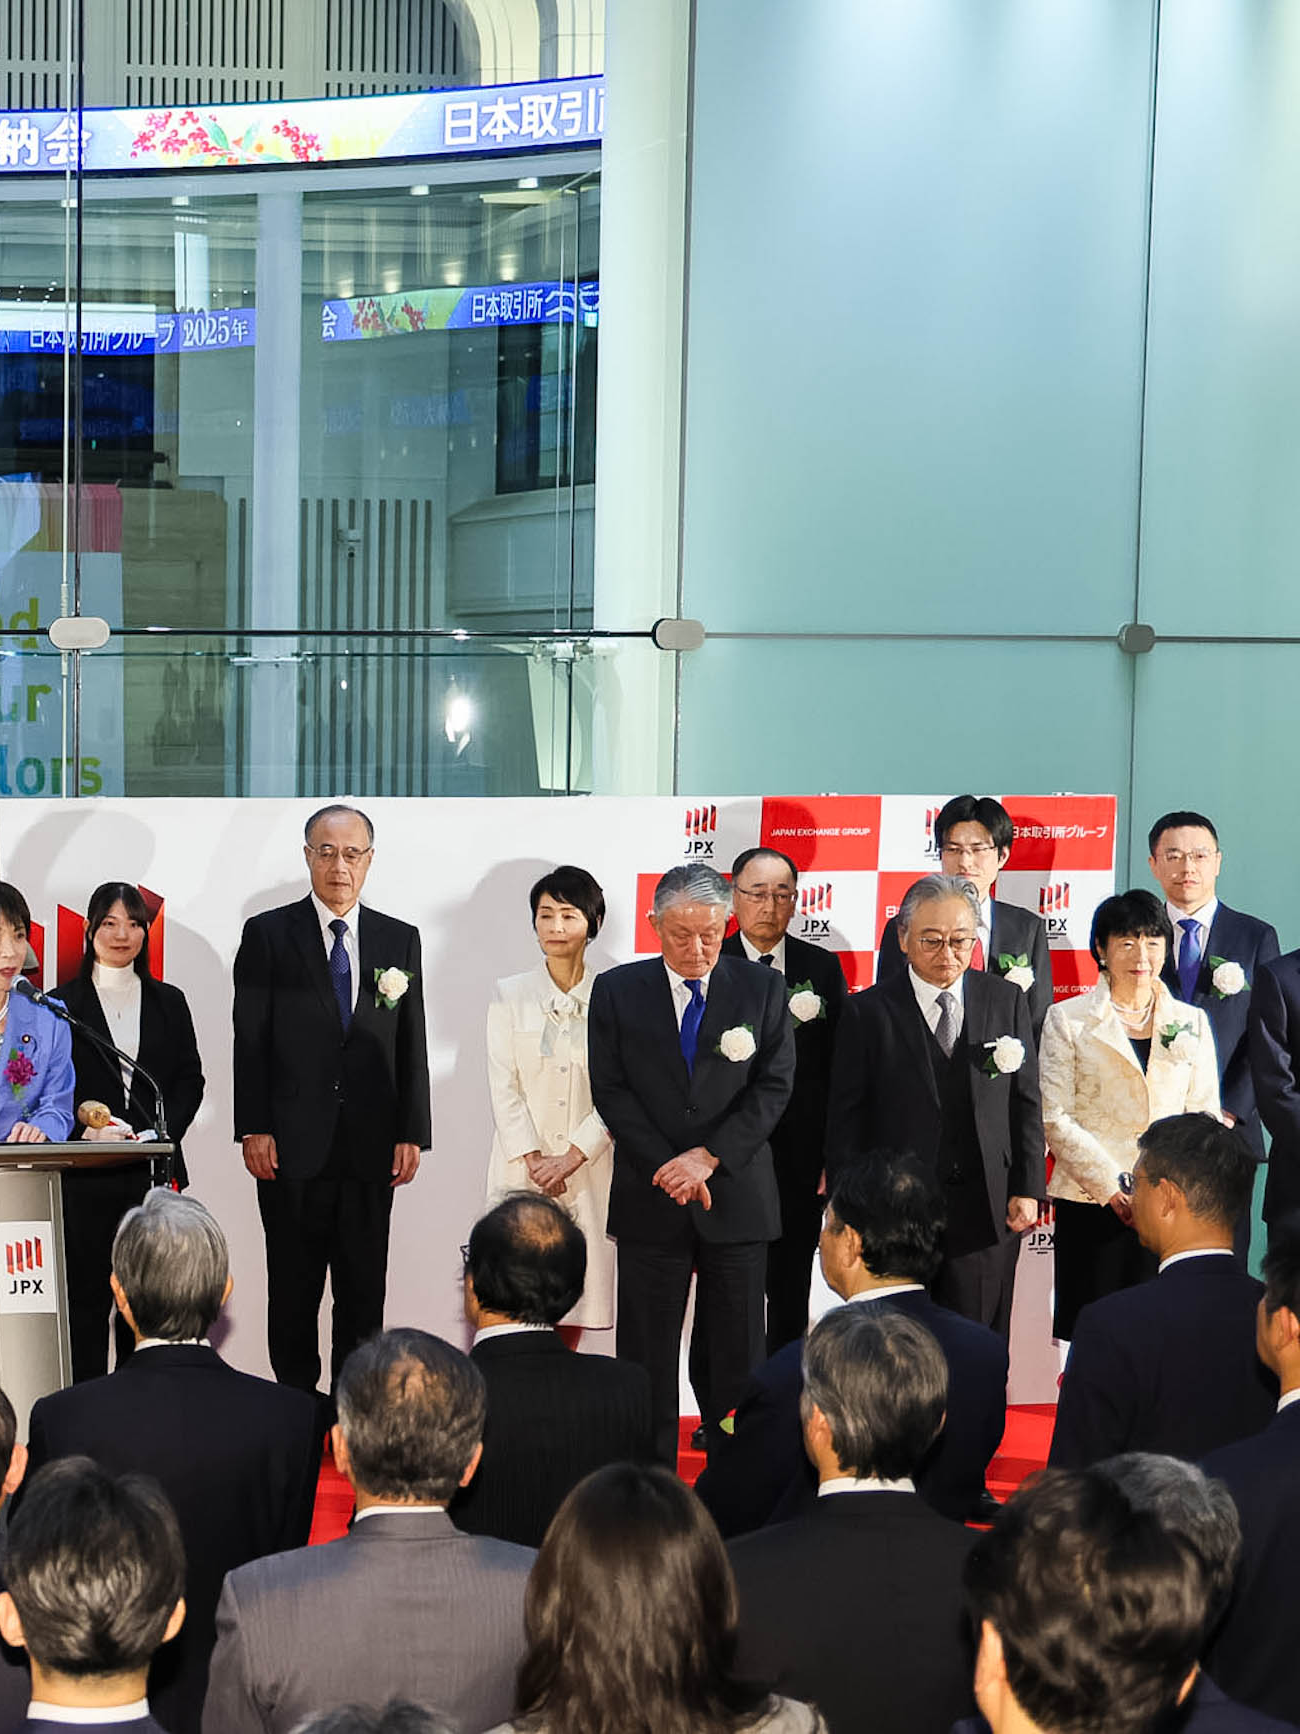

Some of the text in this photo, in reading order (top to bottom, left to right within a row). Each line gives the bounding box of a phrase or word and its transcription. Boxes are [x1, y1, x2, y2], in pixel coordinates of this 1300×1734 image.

[444, 88, 604, 145] 日本取引
[797, 828, 839, 836] EXCHANGE
[841, 827, 871, 835] GROUP
[684, 841, 714, 854] JPX
[801, 920, 830, 932] JPX
[1049, 919, 1067, 931] PX
[9, 1280, 43, 1294] JPX
